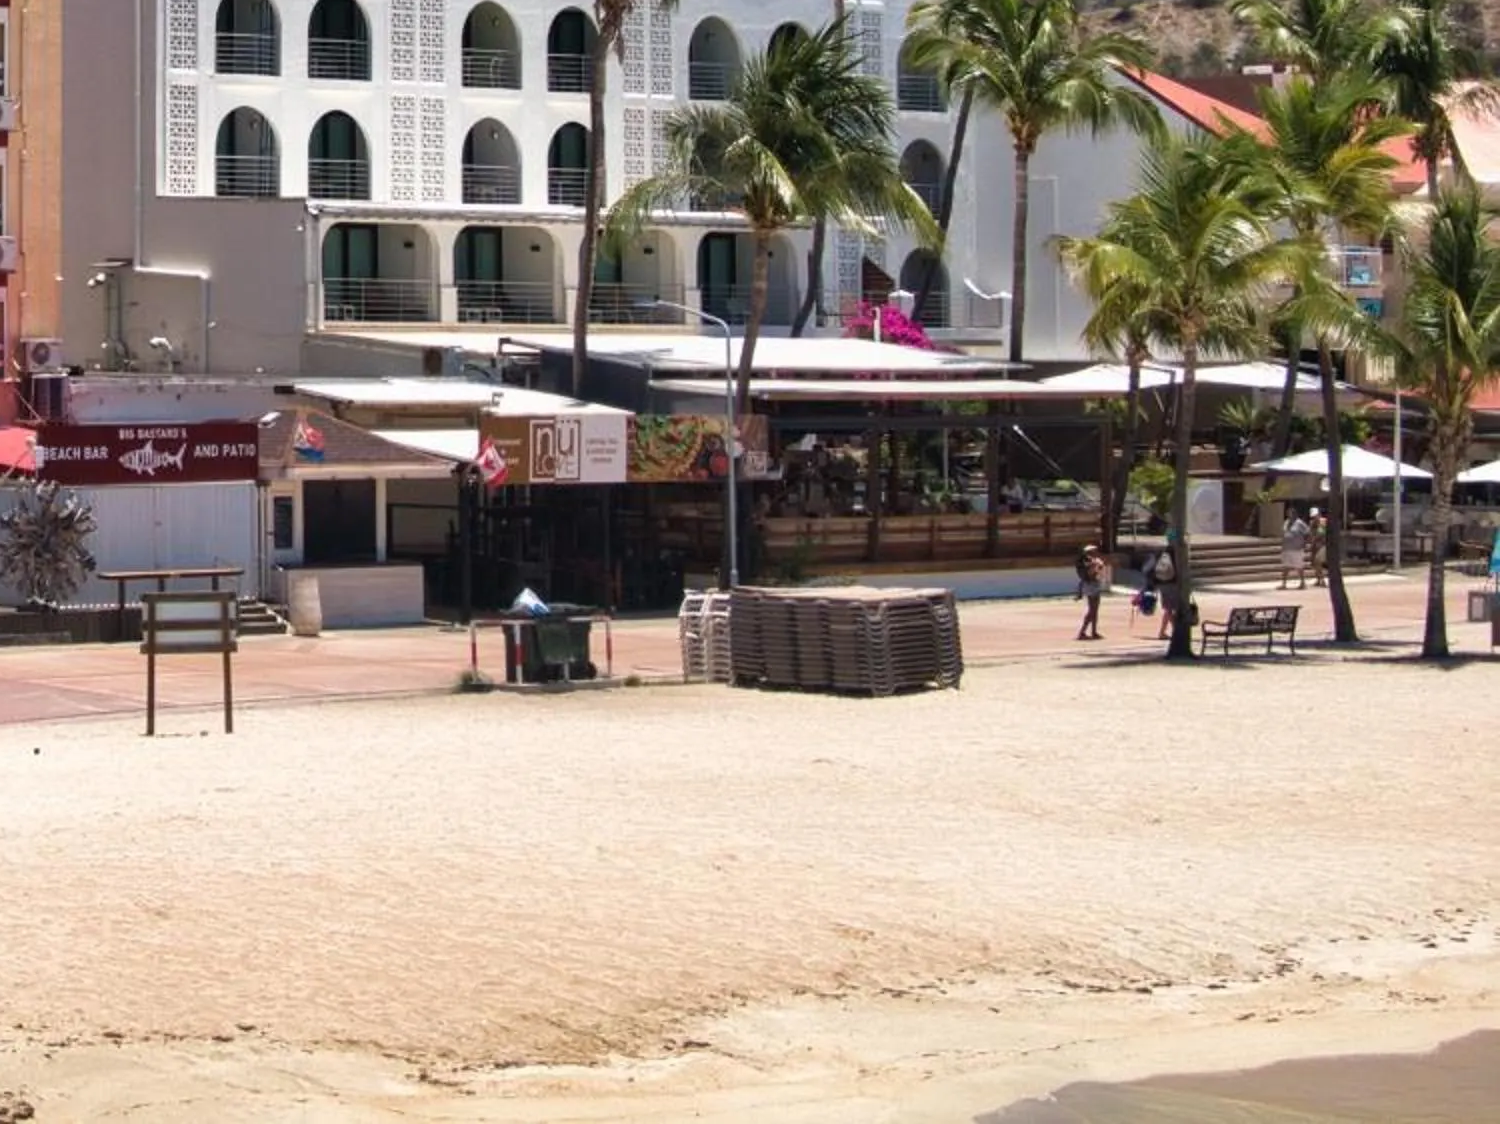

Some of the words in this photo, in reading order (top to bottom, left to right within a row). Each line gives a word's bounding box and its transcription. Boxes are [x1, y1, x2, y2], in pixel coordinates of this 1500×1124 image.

[83, 445, 109, 460] BAR
[193, 444, 219, 458] AND
[222, 443, 256, 458] PATIO
